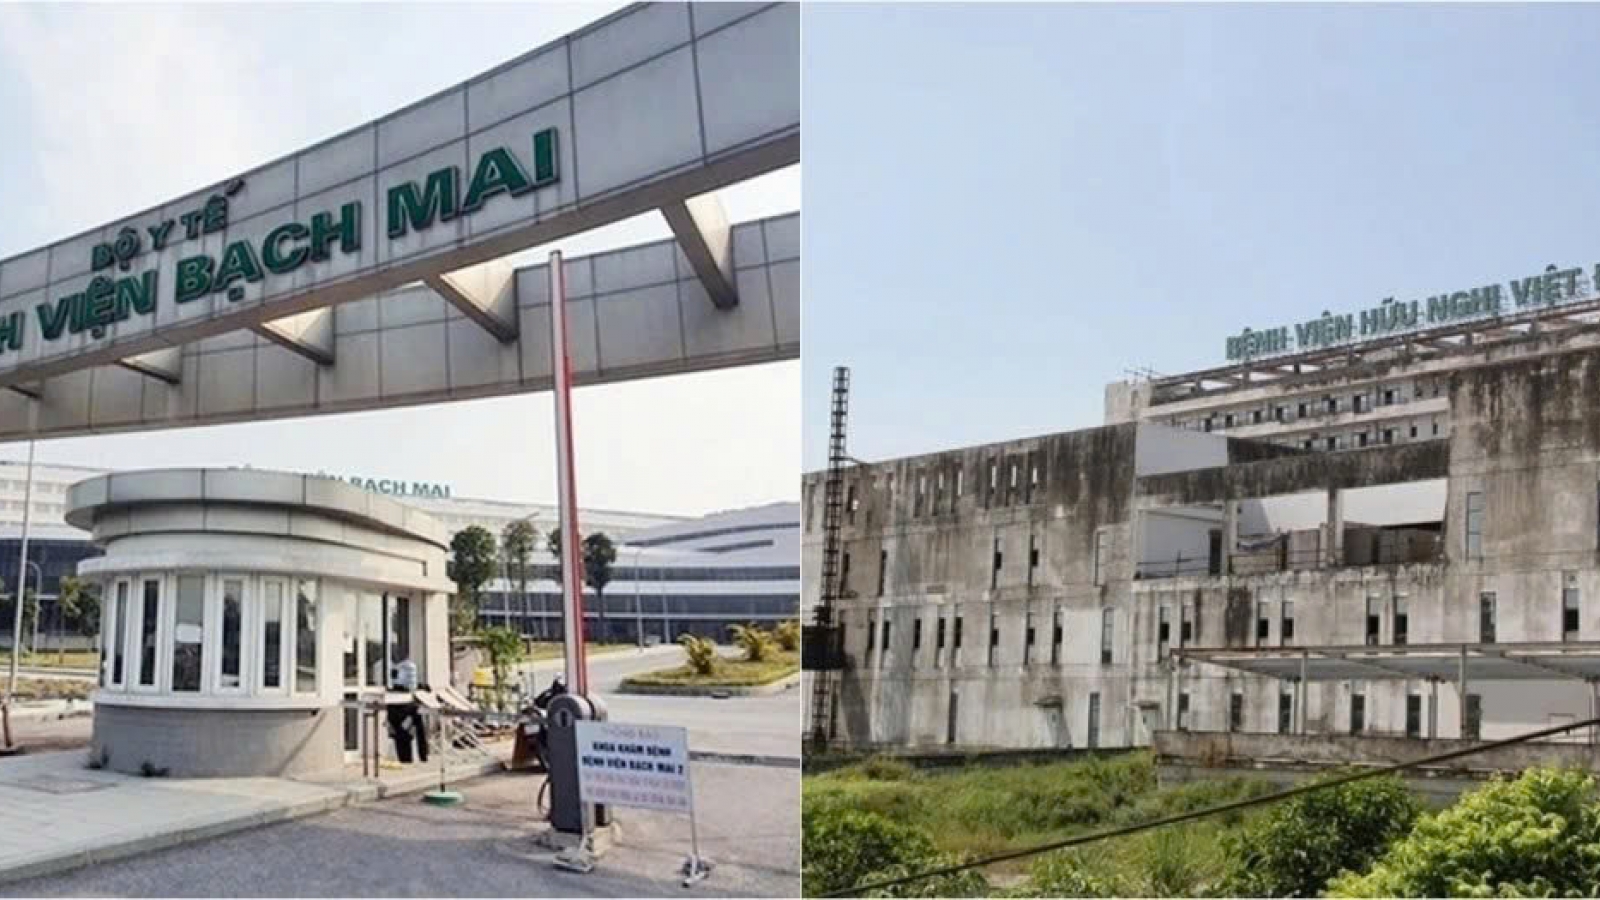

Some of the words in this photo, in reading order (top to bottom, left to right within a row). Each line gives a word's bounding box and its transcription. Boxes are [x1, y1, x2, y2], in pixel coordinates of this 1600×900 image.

[36, 276, 158, 341] VIỆN
[175, 201, 362, 303] BẠCH
[387, 126, 560, 240] MAI
[147, 219, 175, 250] Y
[178, 178, 244, 240] TẾ
[1226, 326, 1288, 361] BỆNH
[1294, 310, 1353, 350] VIỆN
[1359, 297, 1418, 336] HỮU
[1426, 283, 1500, 324] NGHỊ
[1509, 263, 1583, 308] VIỆT
[412, 483, 451, 499] MAI
